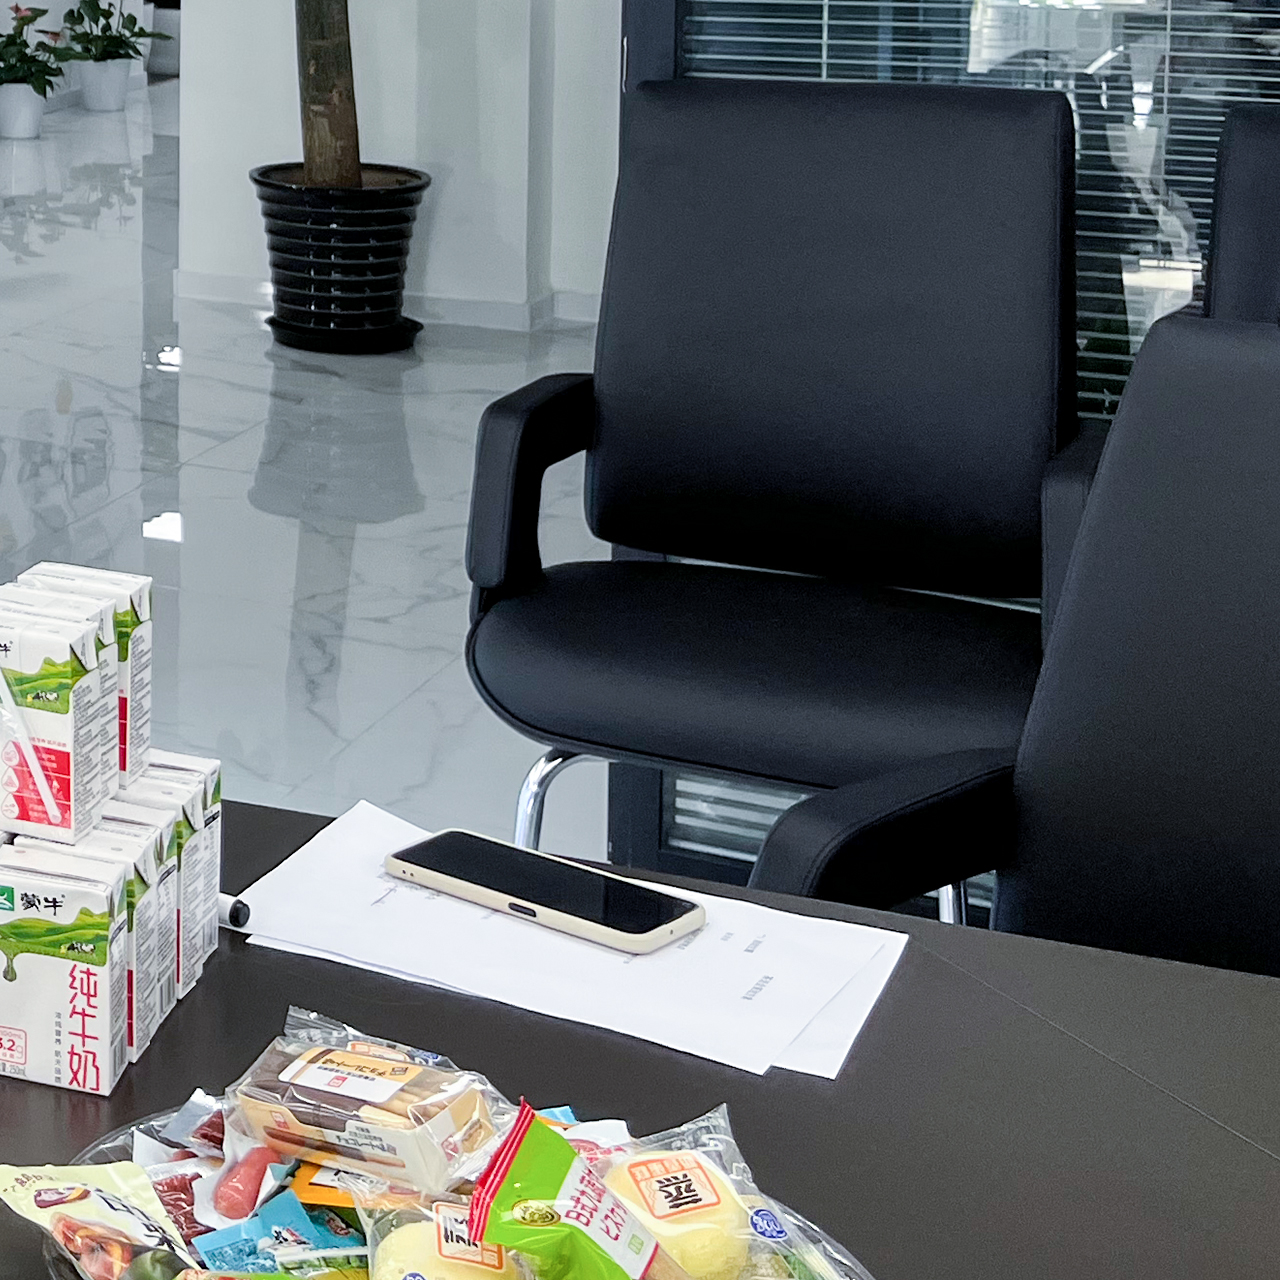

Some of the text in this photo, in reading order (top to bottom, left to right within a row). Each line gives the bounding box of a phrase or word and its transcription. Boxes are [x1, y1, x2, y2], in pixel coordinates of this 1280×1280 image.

[19, 891, 65, 917] 蒙牛
[68, 963, 100, 1092] 纯牛奶
